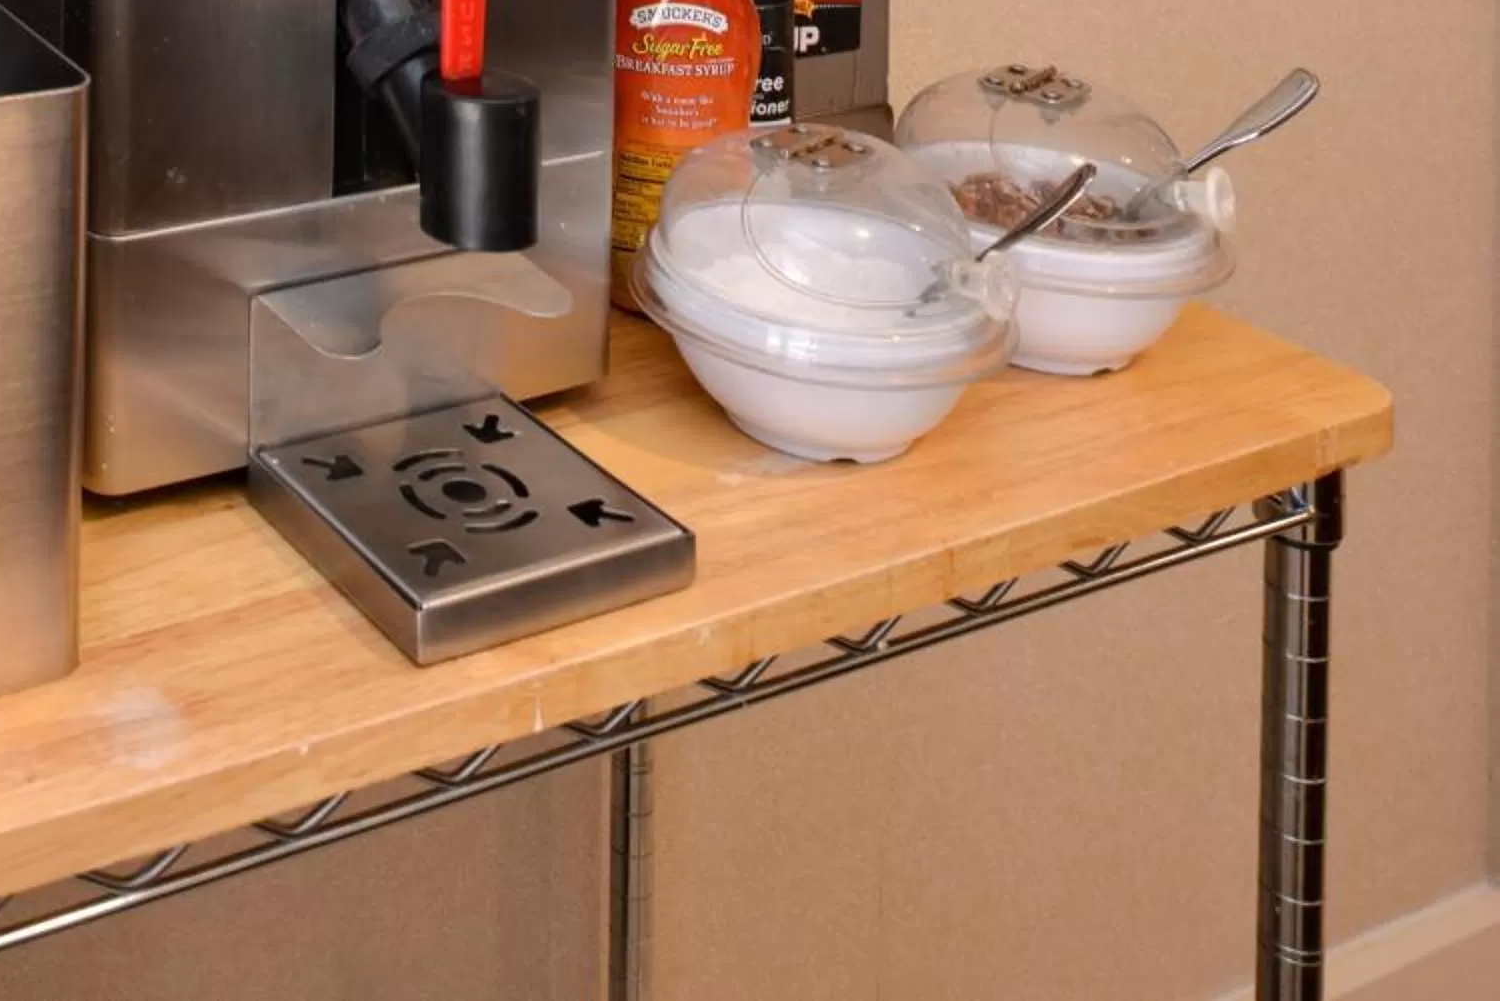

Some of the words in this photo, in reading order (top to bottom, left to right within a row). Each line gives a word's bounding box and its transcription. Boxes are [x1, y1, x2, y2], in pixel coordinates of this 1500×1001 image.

[631, 33, 689, 62] Sugar
[688, 32, 724, 60] Free
[615, 54, 693, 76] BREAKFAST
[695, 61, 736, 76] SYRUP
[755, 75, 785, 92] ree
[751, 99, 791, 116] ioner
